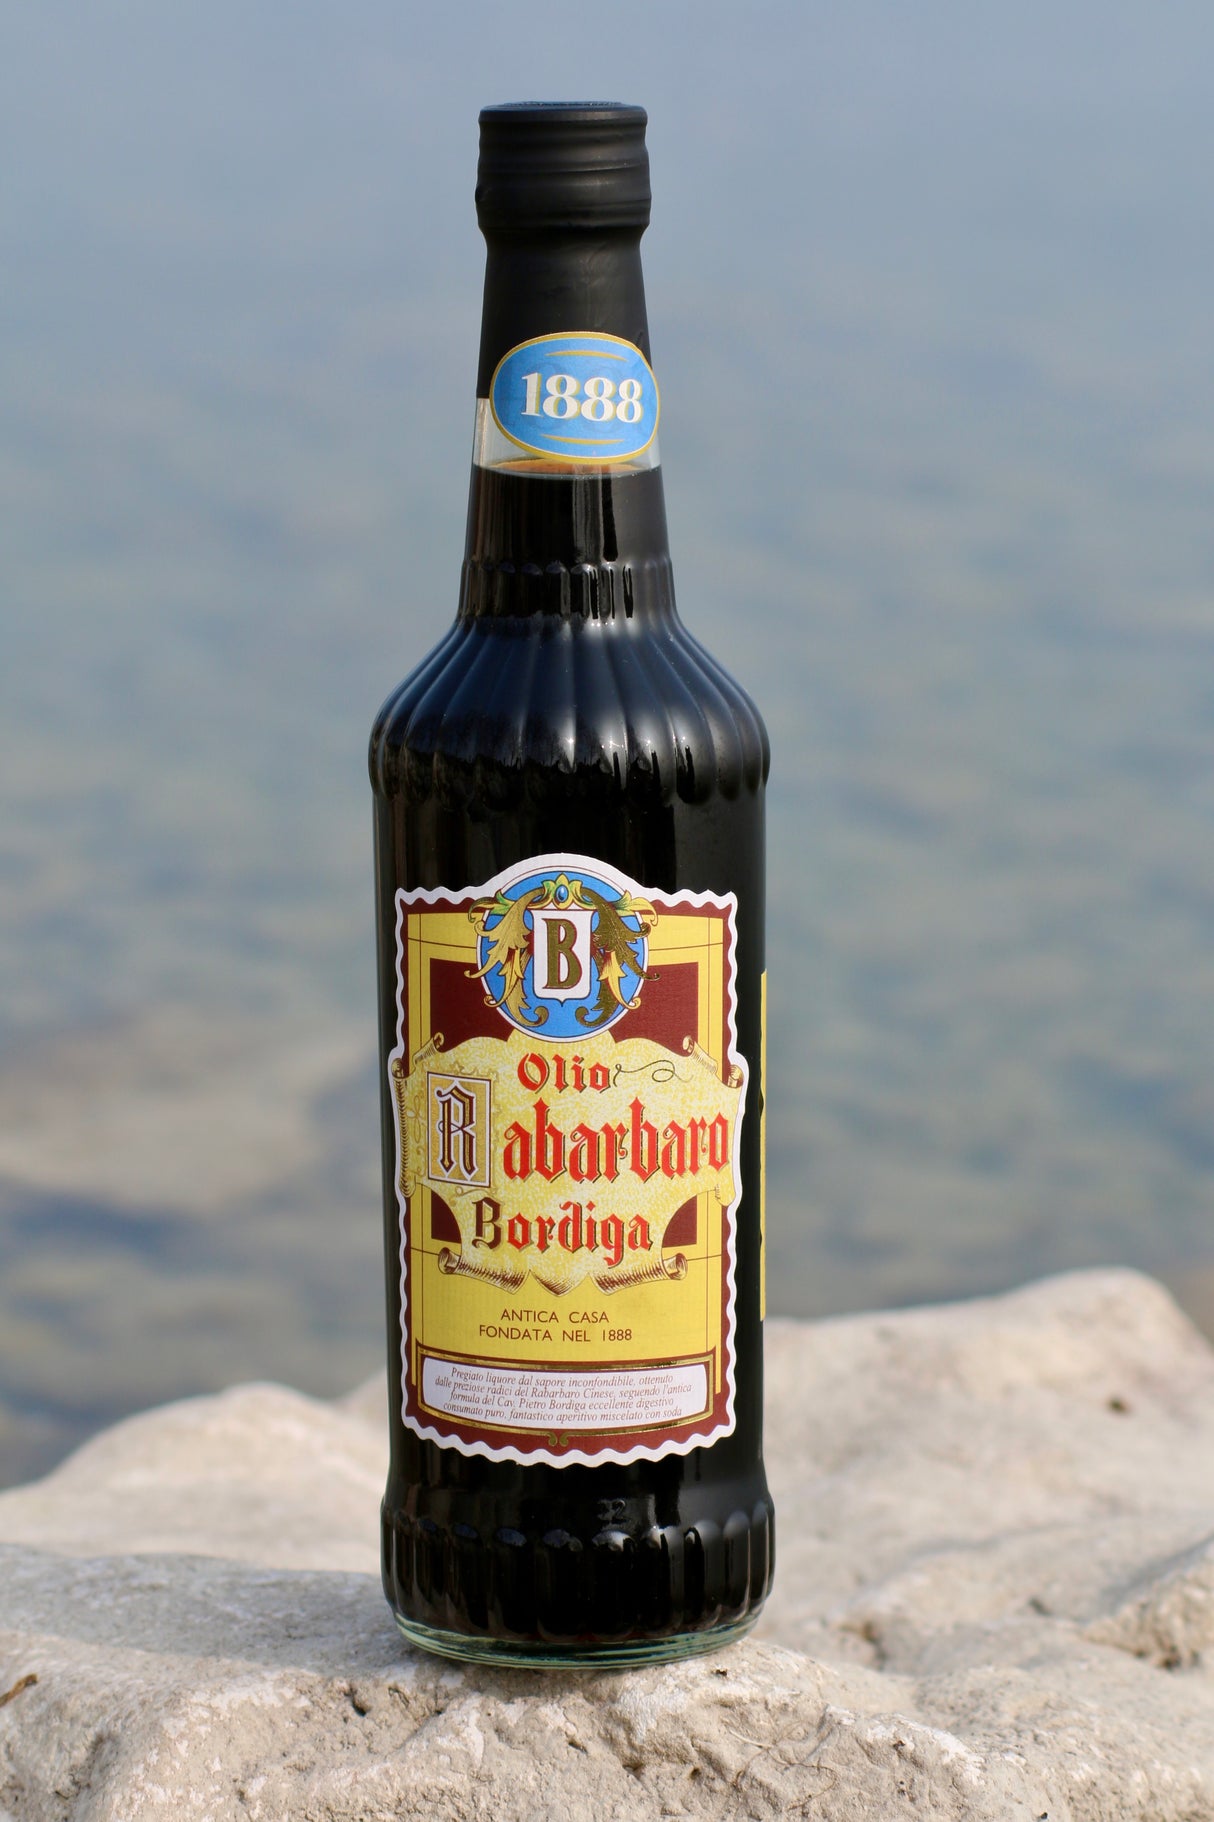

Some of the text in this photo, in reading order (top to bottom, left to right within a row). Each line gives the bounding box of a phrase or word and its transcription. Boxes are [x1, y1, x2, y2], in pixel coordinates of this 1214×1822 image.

[521, 372, 644, 424] 1888
[542, 917, 583, 990] B
[517, 1053, 612, 1093] Olio
[435, 1079, 730, 1184] Rabarbaro
[472, 1197, 653, 1268] Bordiga
[501, 1308, 609, 1324] ANTICA CASA
[479, 1324, 633, 1342] FONDATA NEL 1888
[435, 1376, 452, 1388] dalle
[453, 1382, 485, 1393] preziose
[487, 1386, 512, 1396] radici
[514, 1387, 528, 1397] del
[531, 1388, 580, 1399] Rabarbaro
[618, 1386, 660, 1400] seguendo
[451, 1367, 484, 1382] Pregiato
[486, 1372, 517, 1386] liquore
[518, 1375, 533, 1386] dal
[535, 1378, 566, 1389] sapore
[639, 1374, 674, 1385] ottenuto
[443, 1402, 483, 1415] consumato
[509, 1409, 553, 1421] fantastico
[556, 1411, 598, 1424] aperitivo
[600, 1410, 642, 1421] miscelato
[645, 1410, 660, 1419] con
[663, 1407, 682, 1417] soda
[449, 1391, 480, 1404] formula
[482, 1395, 496, 1405] del
[518, 1398, 546, 1409] Pietro
[549, 1399, 586, 1412] Bordiga
[588, 1399, 634, 1410] eccellente
[636, 1397, 674, 1411] digestivo
